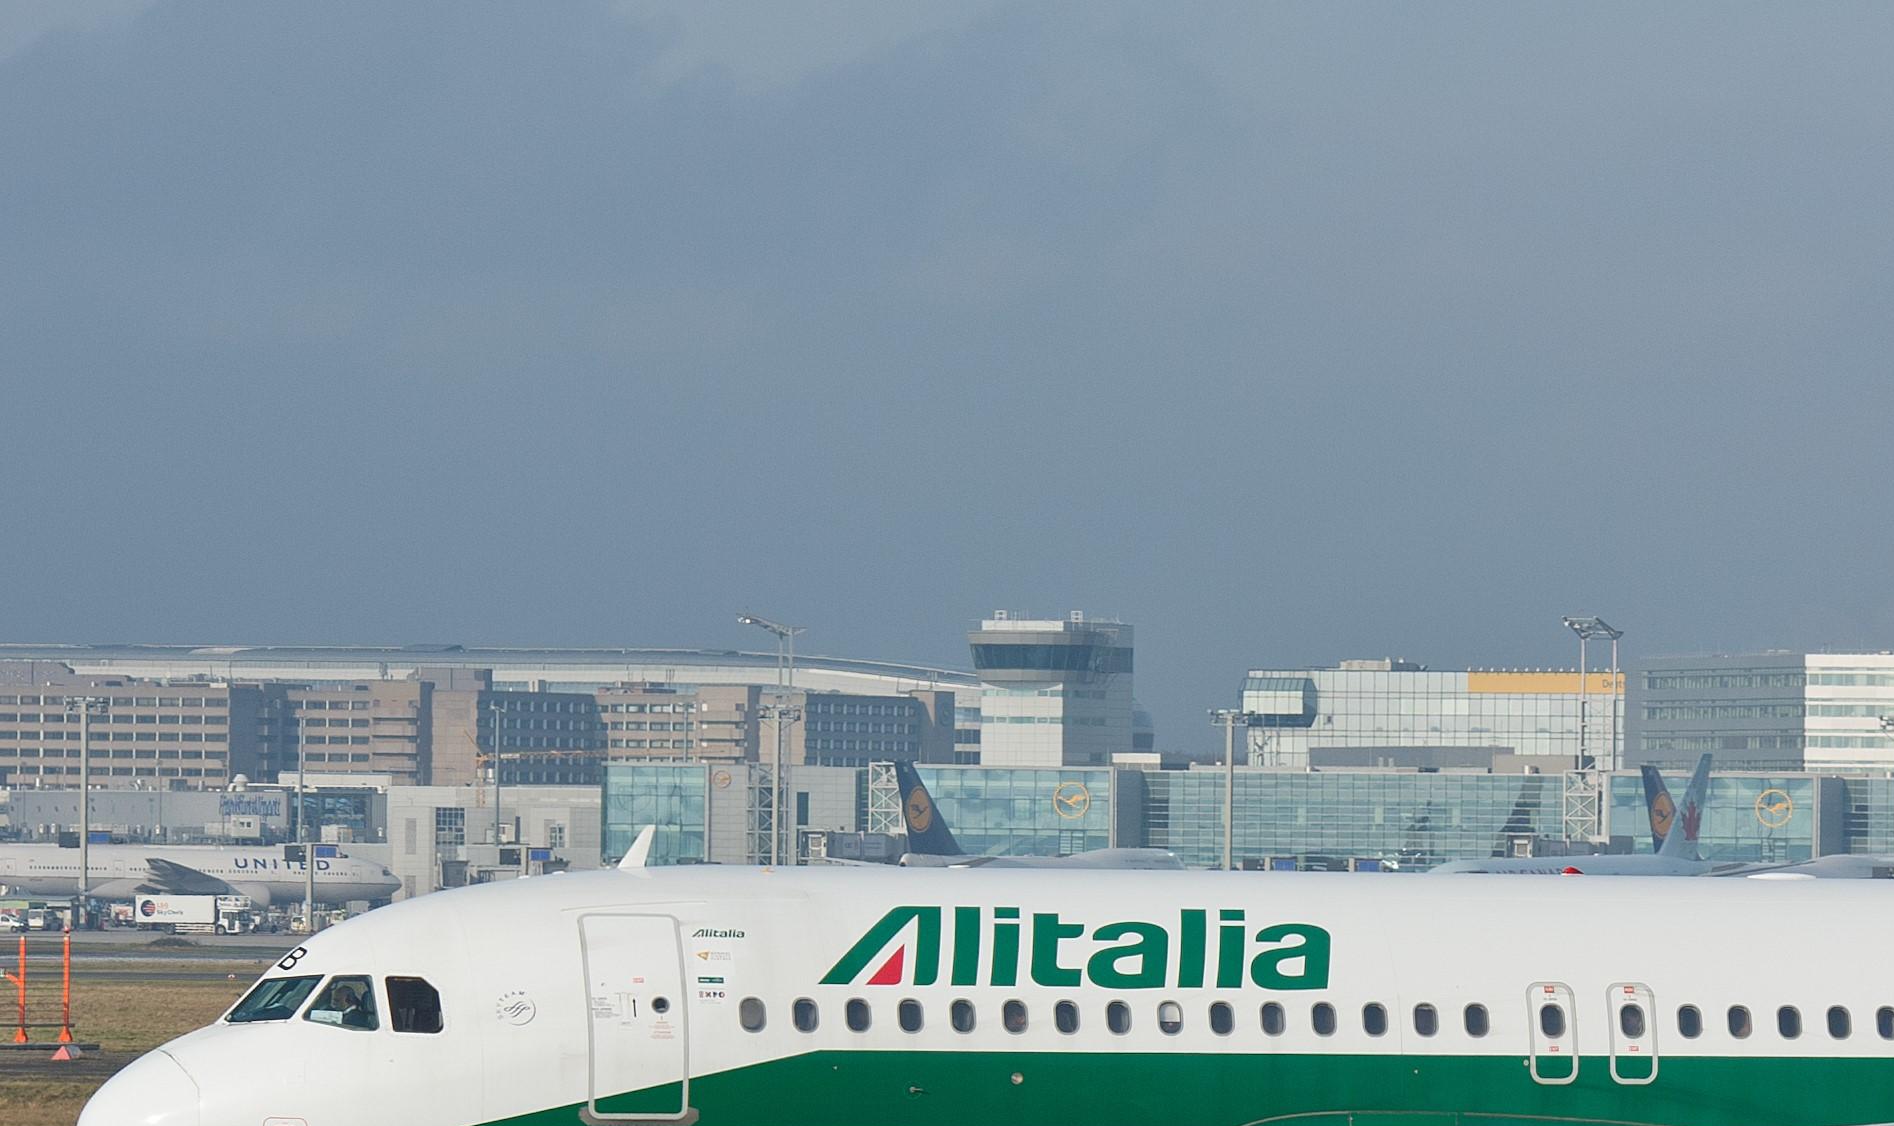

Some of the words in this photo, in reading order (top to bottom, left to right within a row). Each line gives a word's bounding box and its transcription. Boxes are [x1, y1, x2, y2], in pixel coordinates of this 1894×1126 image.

[234, 857, 331, 871] UNITED
[691, 928, 746, 938] Alitalia
[818, 905, 1331, 990] Alitalia
[277, 946, 308, 971] B
